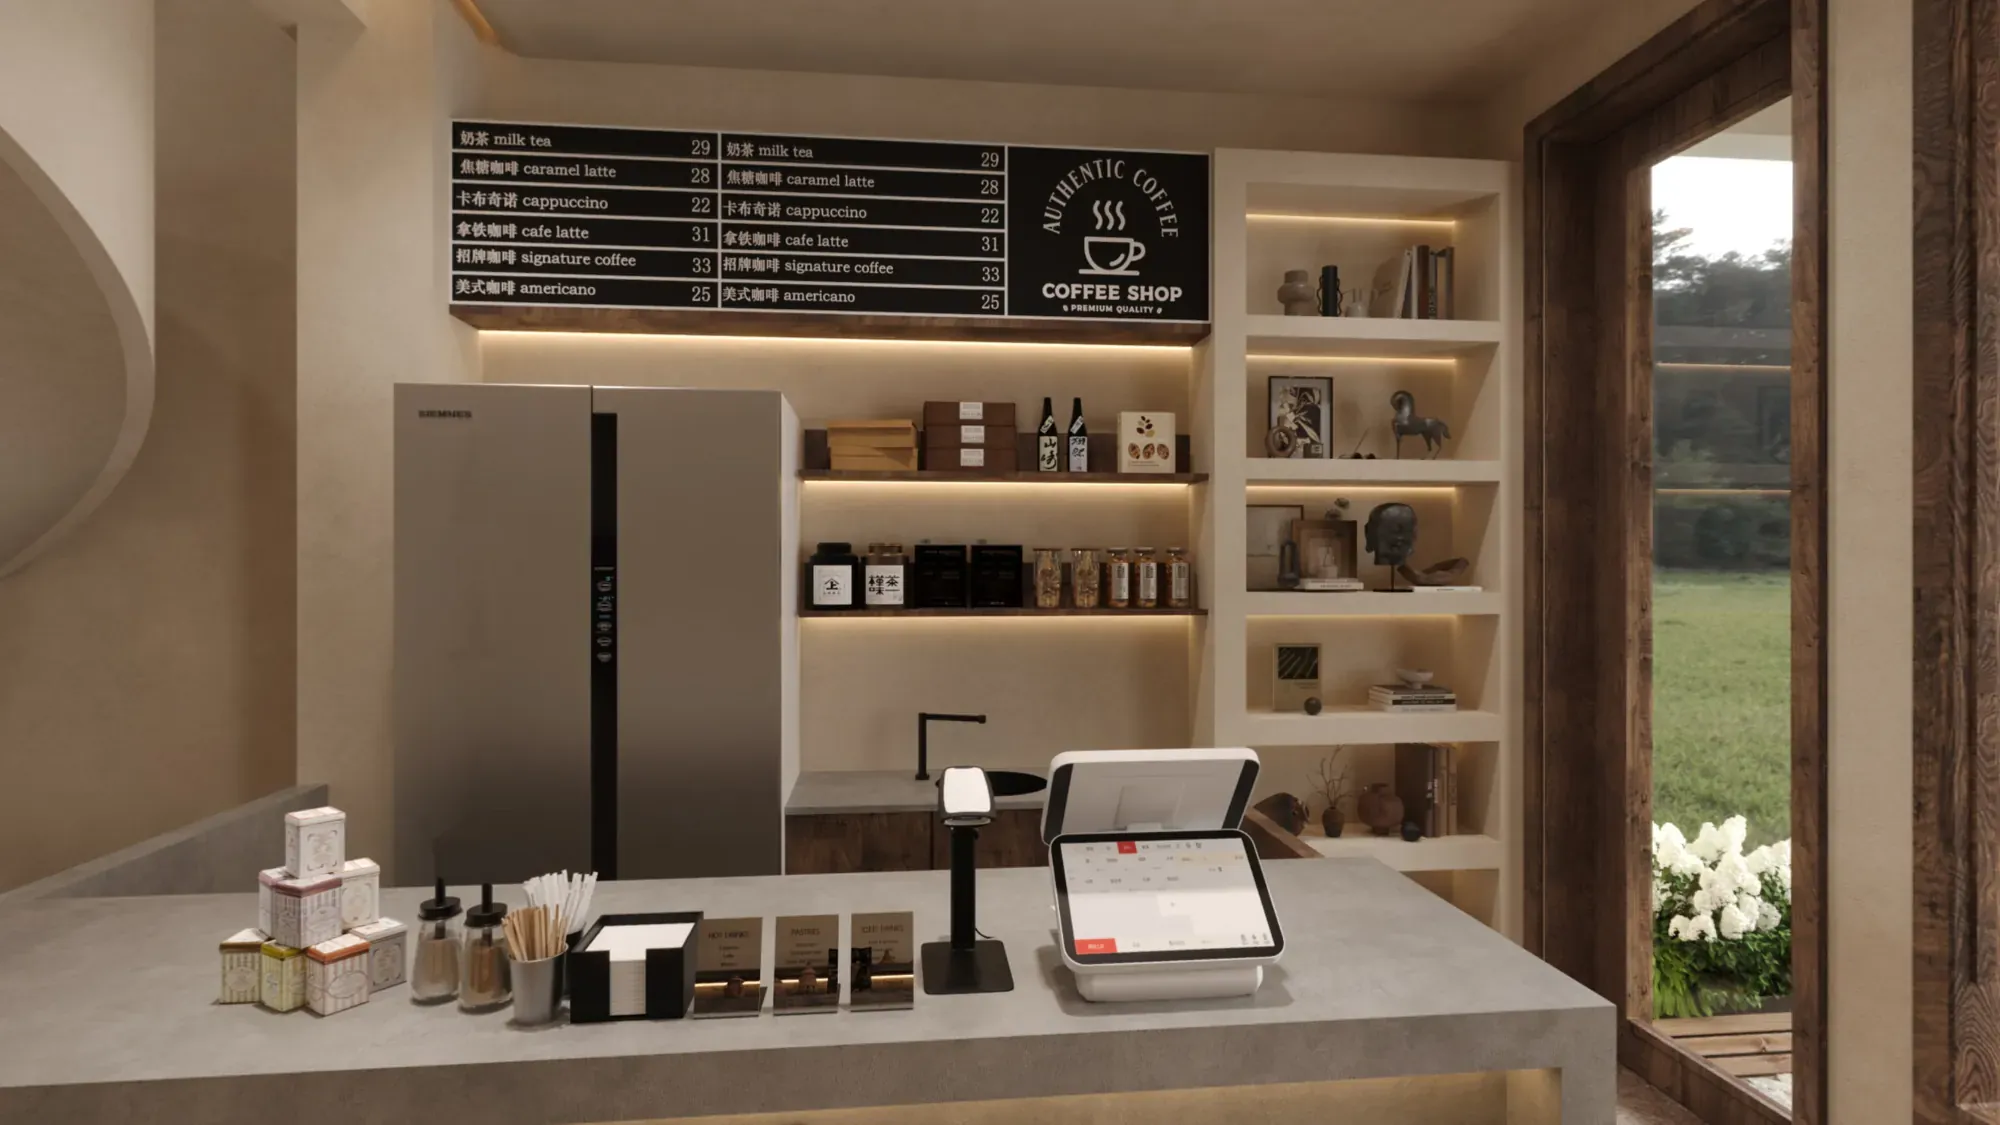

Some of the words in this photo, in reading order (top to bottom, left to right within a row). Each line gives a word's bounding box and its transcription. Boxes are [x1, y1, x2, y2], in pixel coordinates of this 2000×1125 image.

[461, 131, 488, 146] 奶茶
[495, 134, 525, 145] milk
[531, 136, 551, 146] tea
[692, 140, 710, 154] 29
[727, 142, 753, 157] 奶茶
[759, 145, 788, 156] milk
[794, 147, 813, 157] tea
[982, 153, 999, 167] 29
[461, 159, 518, 175] 焦糖咖啡
[524, 164, 579, 176] caramel
[585, 165, 616, 177] latte
[692, 168, 709, 183] 28
[728, 170, 782, 186] 焦糖咖啡
[787, 175, 840, 186] caramel
[845, 175, 874, 187] latte
[981, 180, 998, 194] 28
[457, 191, 517, 208] 卡布奇诺
[523, 196, 608, 210] cappuccino
[692, 197, 710, 212] 22
[1043, 159, 1125, 234] AUTHENTIC
[1133, 169, 1178, 237] COFFEE
[724, 201, 781, 217] 卡布奇诺
[786, 206, 866, 219] cappuccino
[982, 208, 998, 223] 22
[457, 221, 517, 238] 拿铁咖啡
[522, 225, 552, 237] cafe
[556, 226, 588, 238] latte
[693, 227, 709, 241] 31
[724, 231, 780, 247] 拿铁咖啡
[786, 234, 813, 246] cafe
[818, 235, 848, 247] latte
[982, 237, 997, 251] 31
[456, 248, 516, 264] 招牌咖啡
[522, 251, 590, 266] signature
[595, 253, 636, 266] coffee
[693, 258, 711, 273] 33
[723, 257, 780, 272] 招牌咖啡
[785, 260, 850, 274] signature
[855, 262, 893, 274] coffee
[982, 267, 999, 281] 33
[456, 279, 515, 295] 美式咖啡
[520, 283, 596, 295] americano
[692, 286, 710, 301] 25
[723, 287, 779, 302] 美式咖啡
[784, 290, 855, 302] americano
[982, 295, 999, 309] 25
[1042, 283, 1120, 300] COFFEE
[1128, 286, 1182, 301] SHOP
[1071, 304, 1112, 312] PREMIUM
